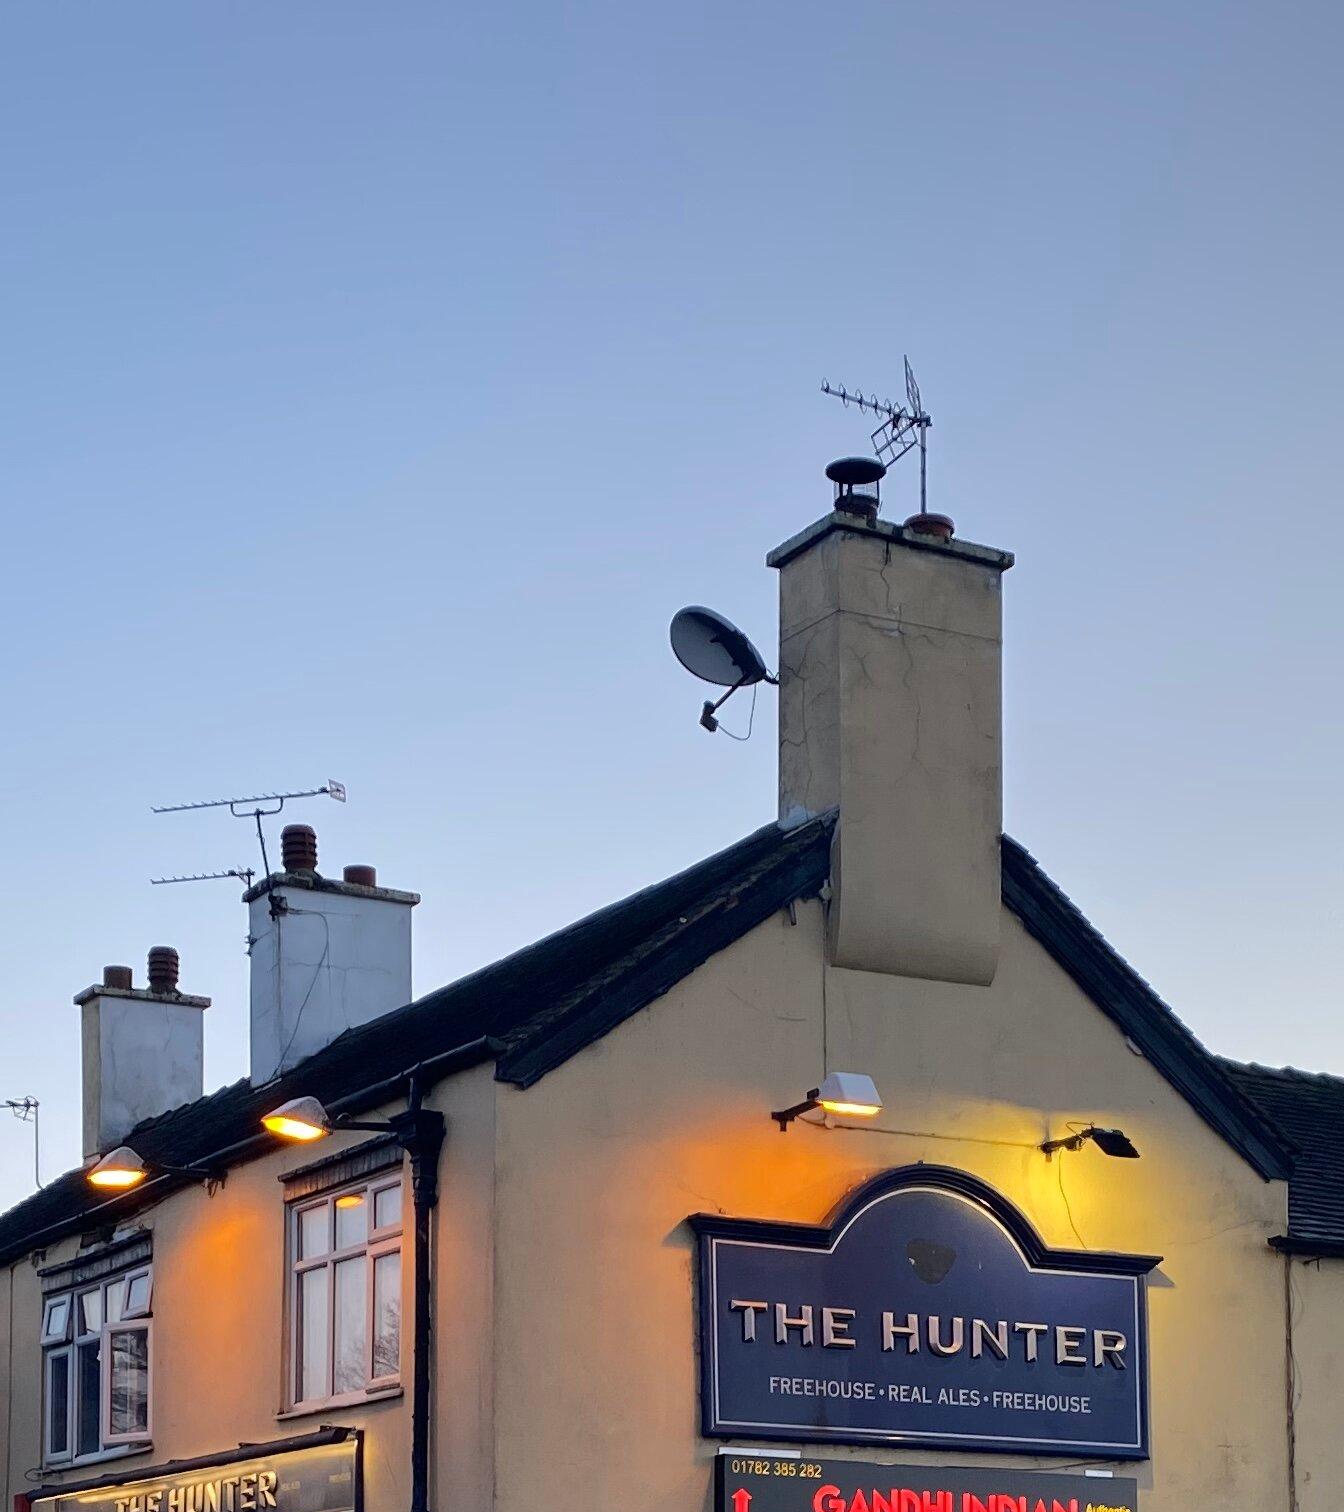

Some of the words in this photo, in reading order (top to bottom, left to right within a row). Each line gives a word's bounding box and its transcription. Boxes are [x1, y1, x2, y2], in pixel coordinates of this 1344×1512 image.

[729, 1299, 856, 1348] THE
[882, 1311, 1127, 1369] HUNTER
[769, 1376, 876, 1400] FREEHOUSE
[888, 1384, 932, 1404] REAL
[938, 1388, 980, 1407] ALES
[993, 1391, 1091, 1414] FREEHOUSE
[731, 1459, 770, 1475] 01782
[773, 1461, 797, 1477] 385
[799, 1462, 822, 1478] 282
